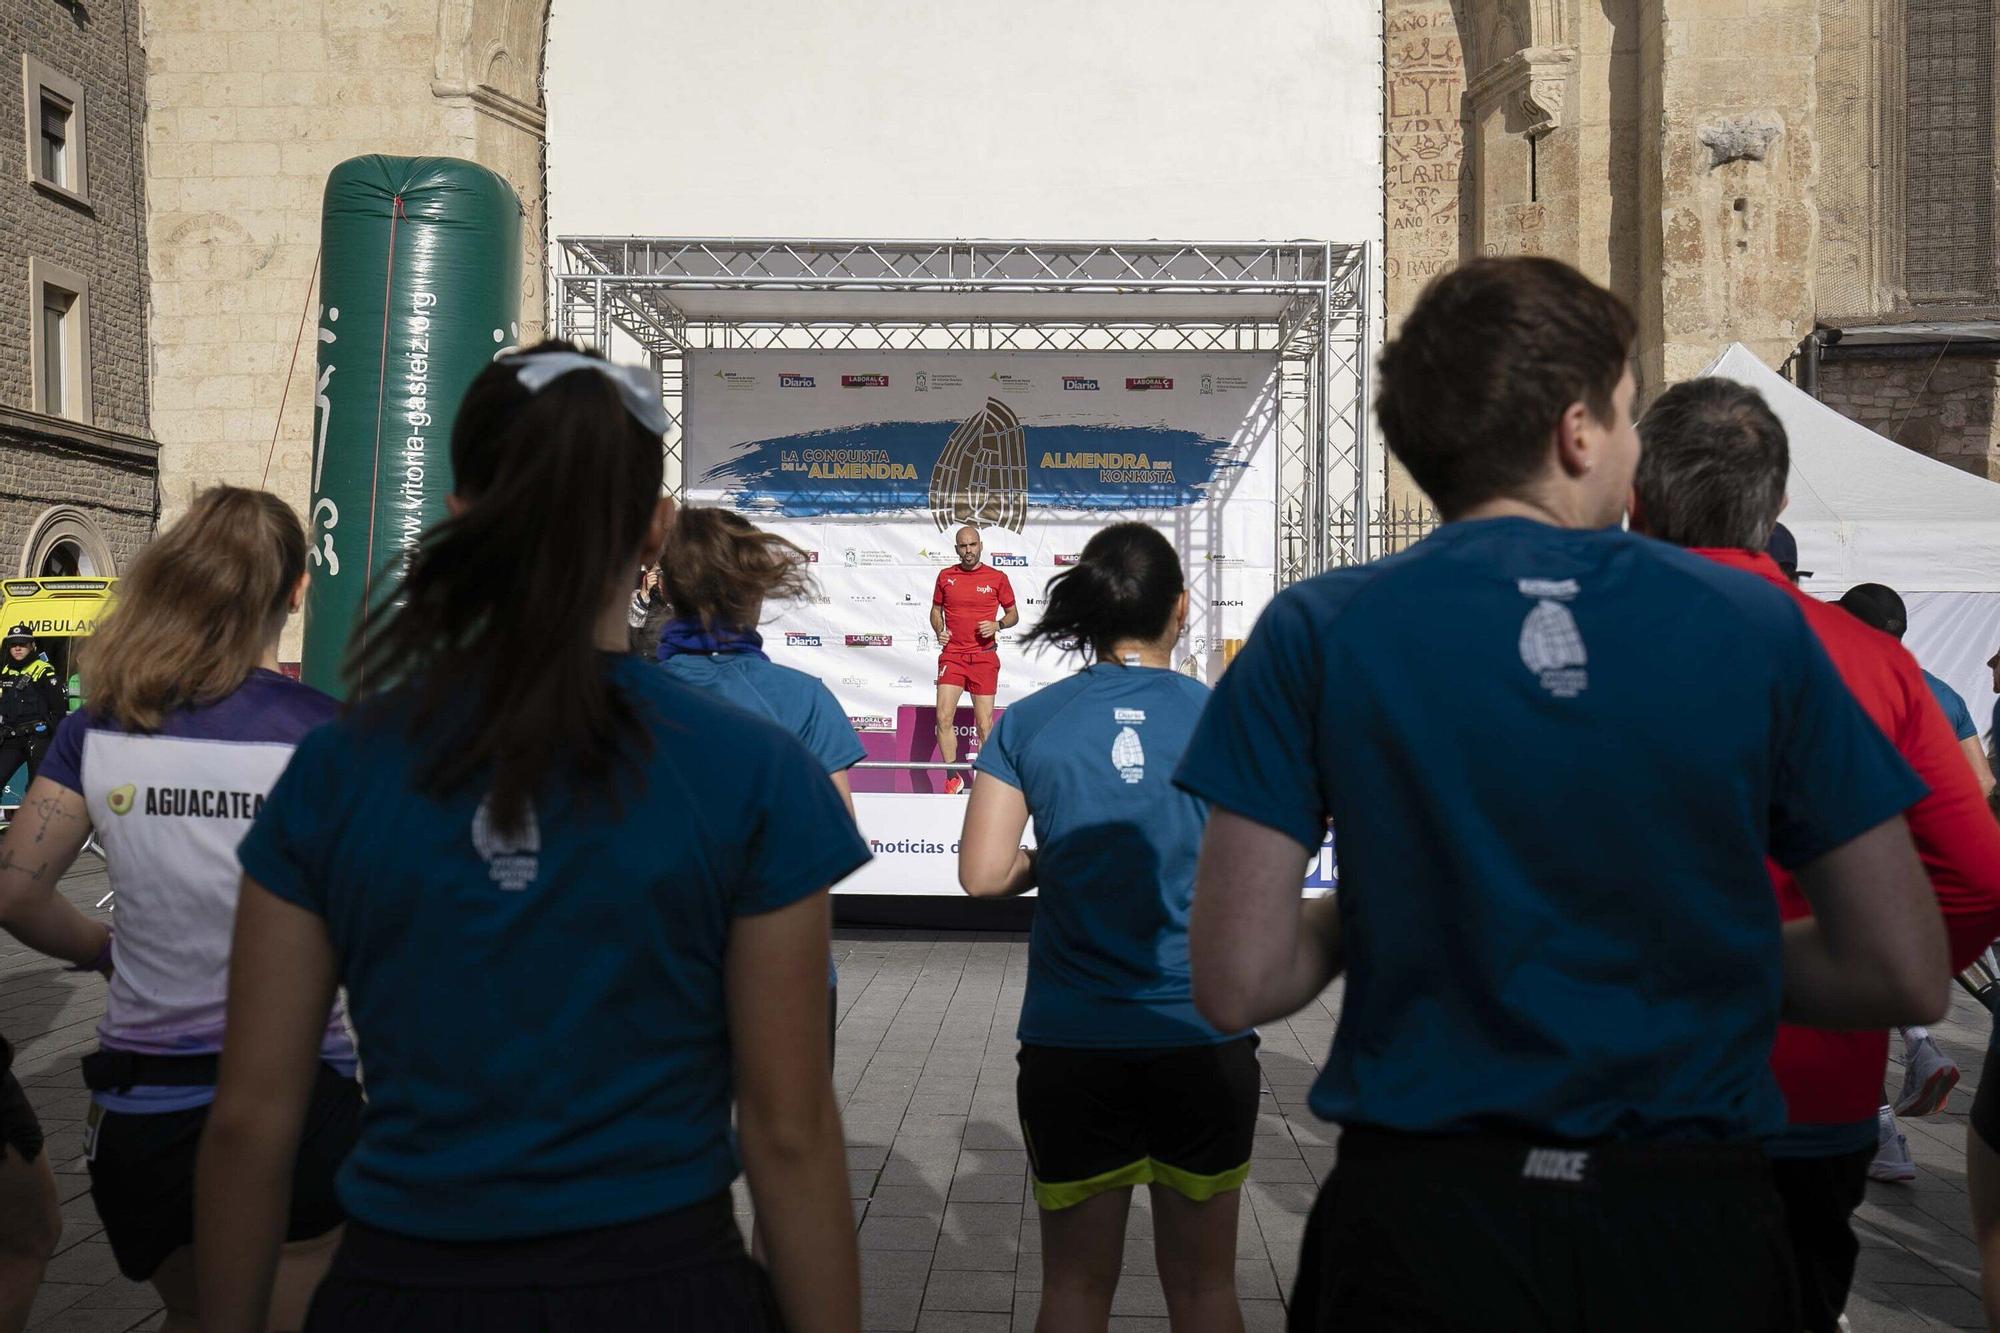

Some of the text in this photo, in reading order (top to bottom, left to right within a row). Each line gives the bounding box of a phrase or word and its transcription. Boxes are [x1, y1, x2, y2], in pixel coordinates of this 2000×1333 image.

[783, 377, 812, 387] Diario
[1066, 381, 1096, 390] Diario
[400, 291, 437, 573] ww.vitoria-gasteiz.org
[781, 449, 890, 464] LA CONQUISTA
[1040, 452, 1151, 469] ALMENDRA
[781, 462, 919, 480] DE LA ALMENDRA
[1100, 470, 1176, 484] KONKISTA
[995, 556, 1025, 566] Diario
[789, 636, 818, 646] Diario
[873, 839, 945, 854] noticias
[1523, 1147, 1589, 1181] NIKE
